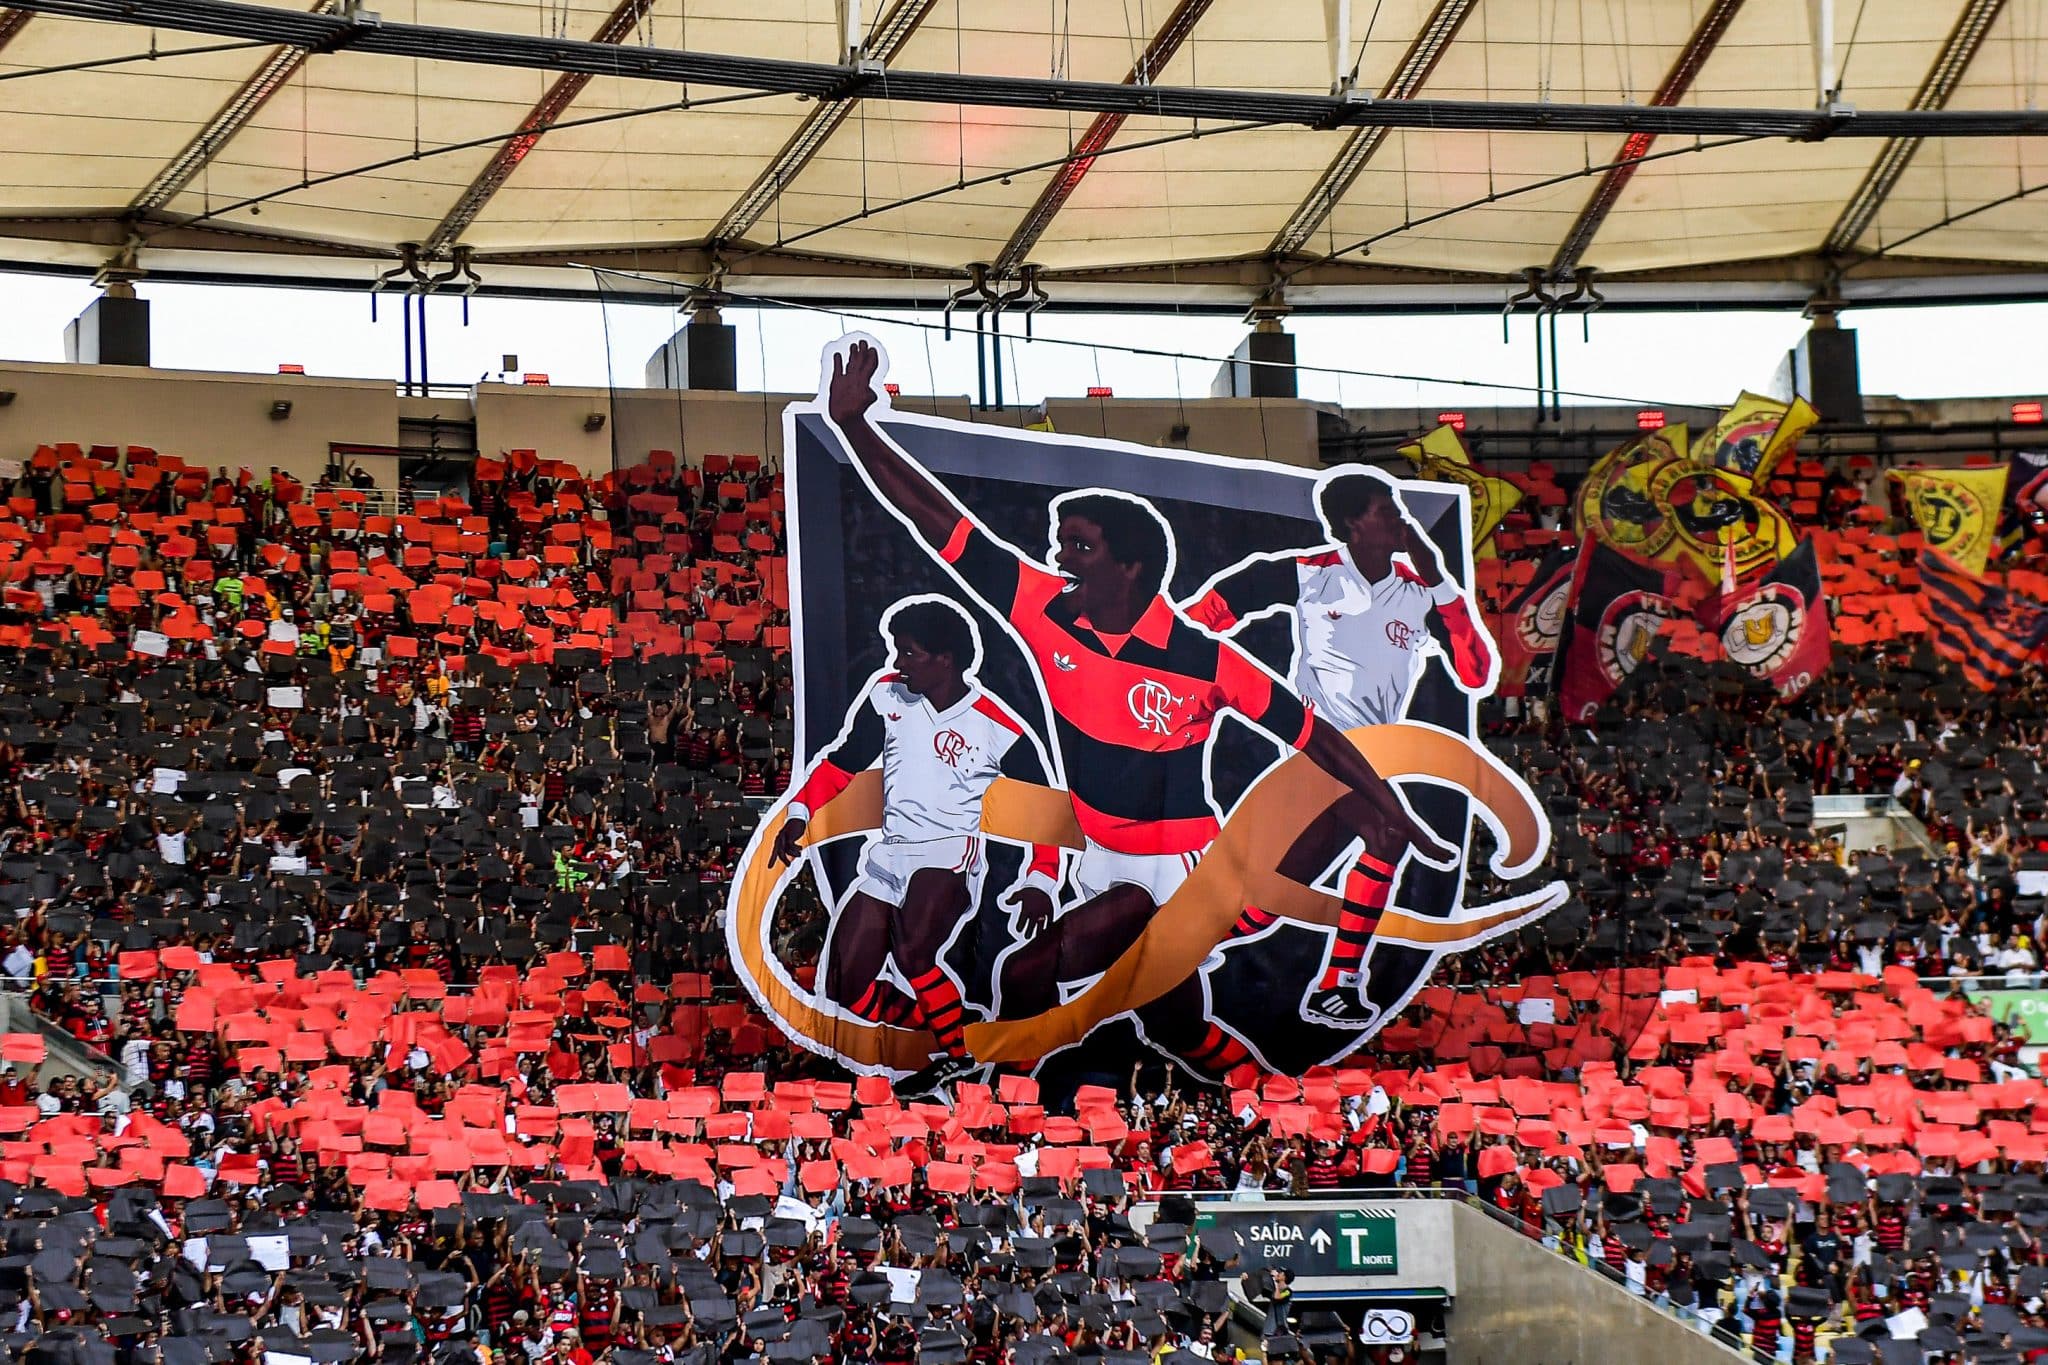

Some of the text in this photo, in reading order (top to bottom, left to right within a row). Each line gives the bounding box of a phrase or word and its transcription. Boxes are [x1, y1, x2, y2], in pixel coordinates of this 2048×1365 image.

[1250, 1222, 1304, 1241] SAÍDA
[1263, 1244, 1293, 1257] EXIT
[1341, 1228, 1368, 1265] T
[1362, 1255, 1393, 1265] NORTE
